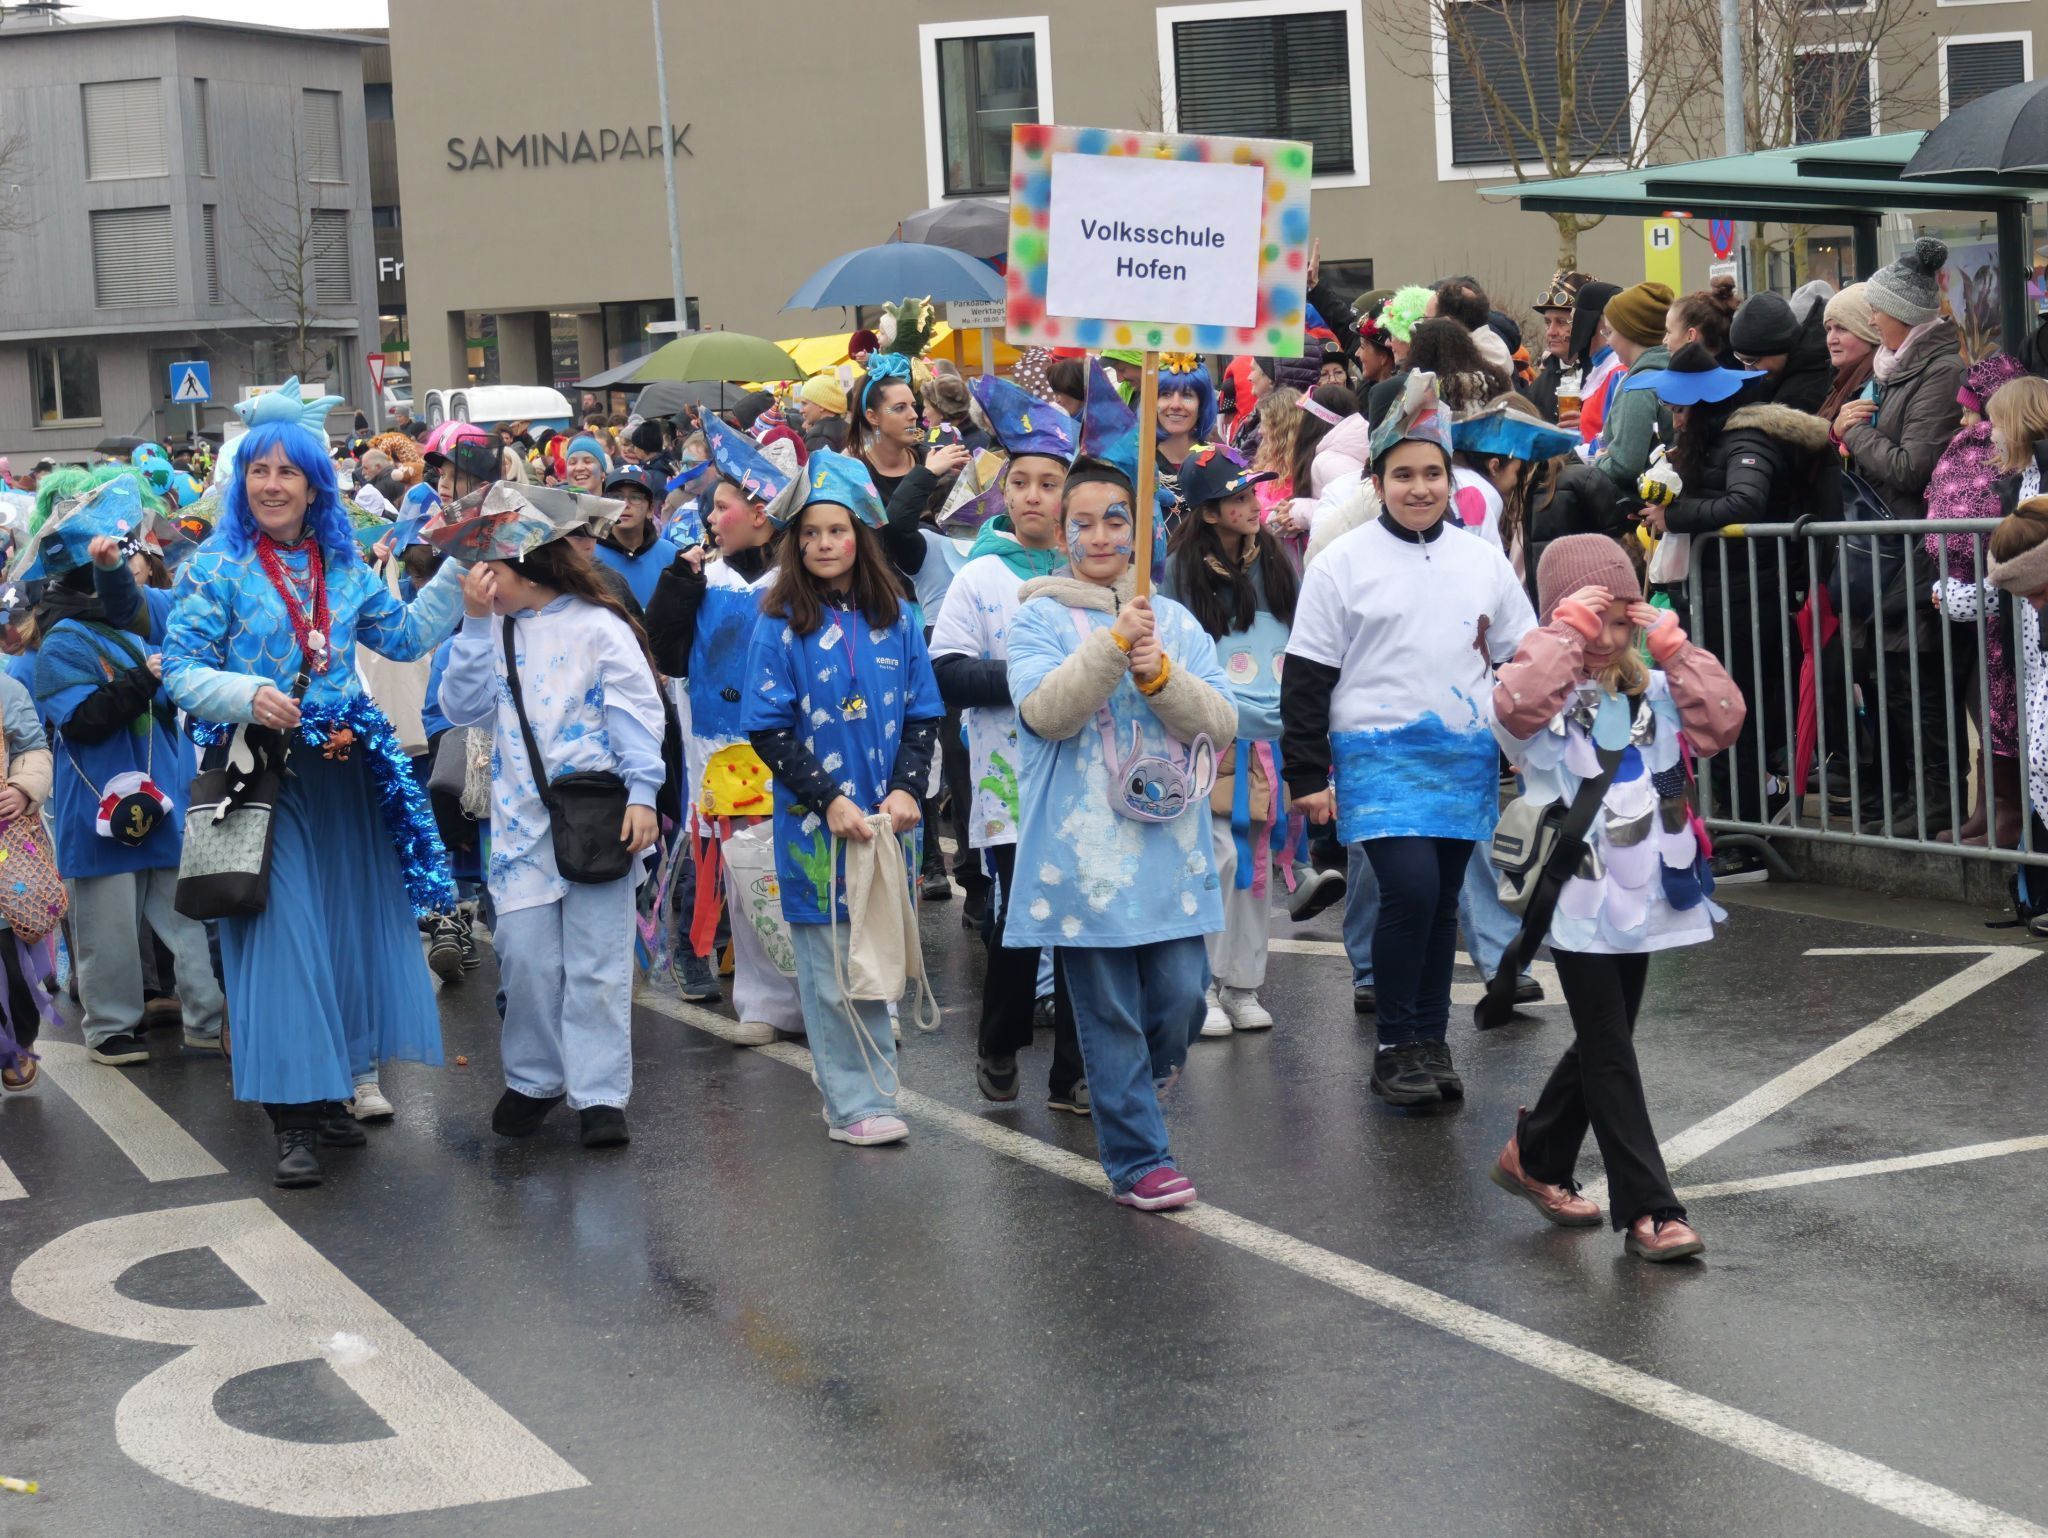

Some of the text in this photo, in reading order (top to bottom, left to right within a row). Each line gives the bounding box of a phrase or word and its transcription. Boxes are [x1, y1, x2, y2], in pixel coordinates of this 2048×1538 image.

[446, 122, 695, 172] SAMINAPARK
[1080, 218, 1226, 249] Volksschule
[1653, 227, 1670, 247] H
[379, 257, 404, 282] Fr
[1116, 256, 1188, 282] Hofen
